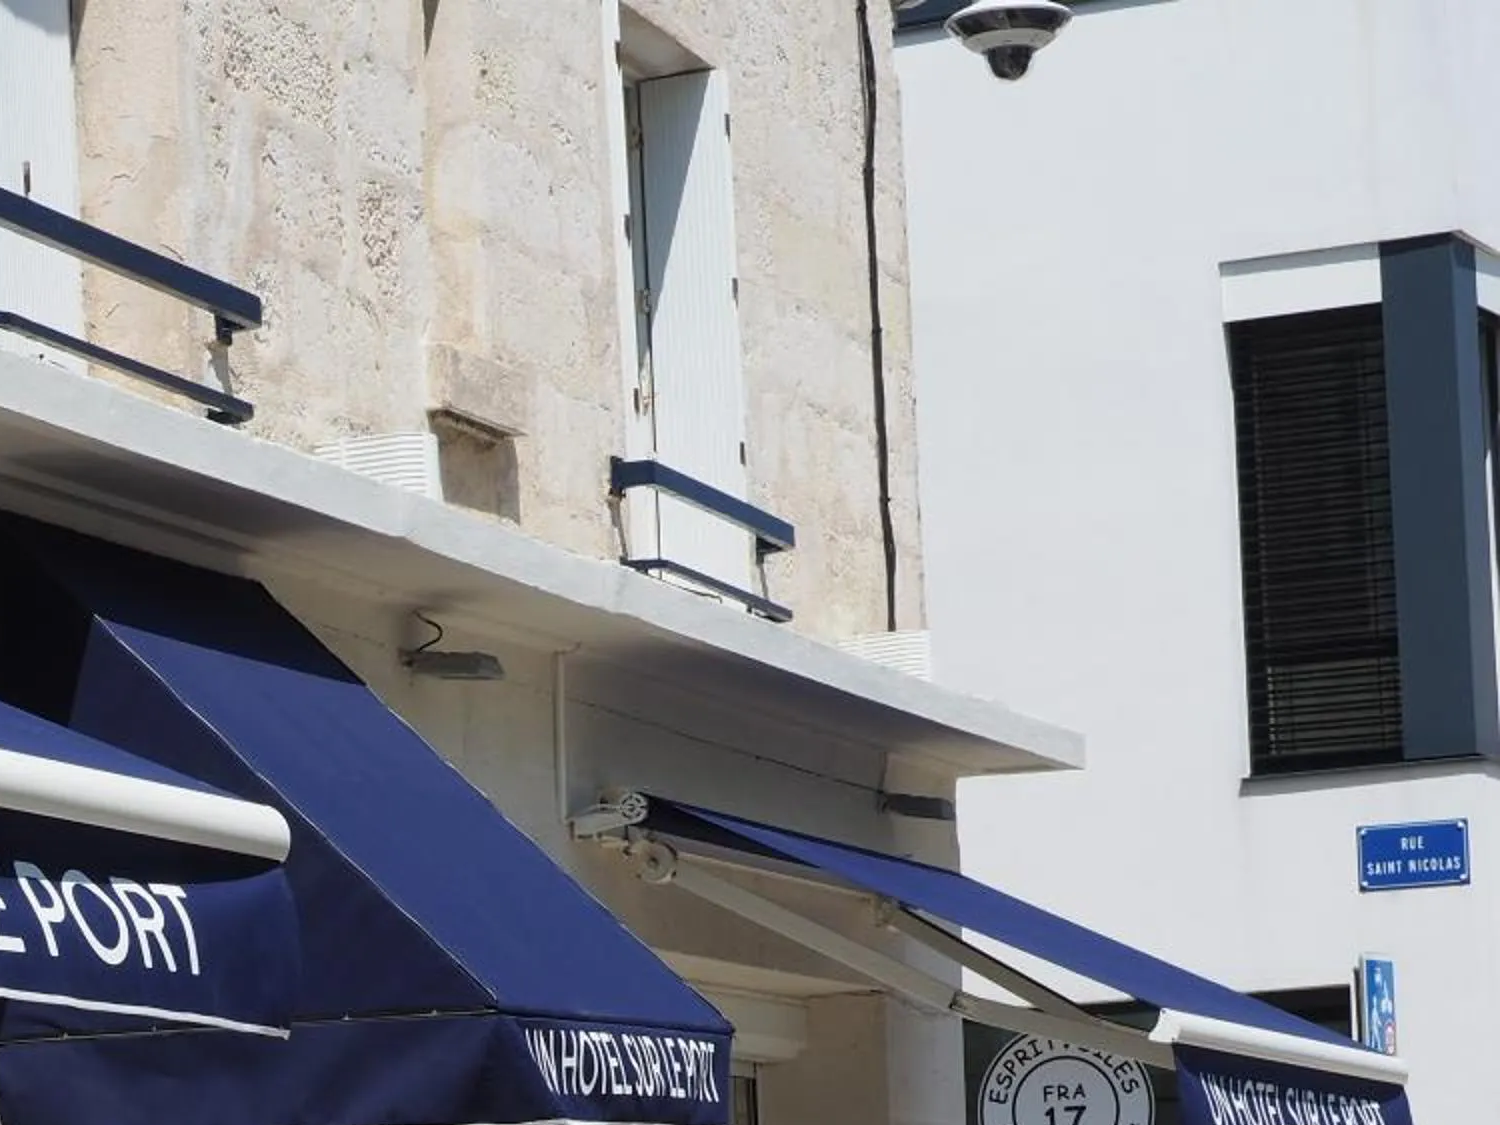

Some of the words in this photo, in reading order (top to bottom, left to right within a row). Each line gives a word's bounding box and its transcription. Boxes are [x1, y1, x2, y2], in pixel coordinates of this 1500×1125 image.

[1400, 835, 1425, 851] RUE
[1366, 859, 1402, 876] SAINT
[1407, 855, 1462, 873] NICOLAS
[13, 861, 200, 976] PORT
[560, 1029, 633, 1096] HOTEL
[621, 1033, 665, 1097] SUR
[656, 1037, 686, 1099] LE
[1043, 1083, 1087, 1102] FRA
